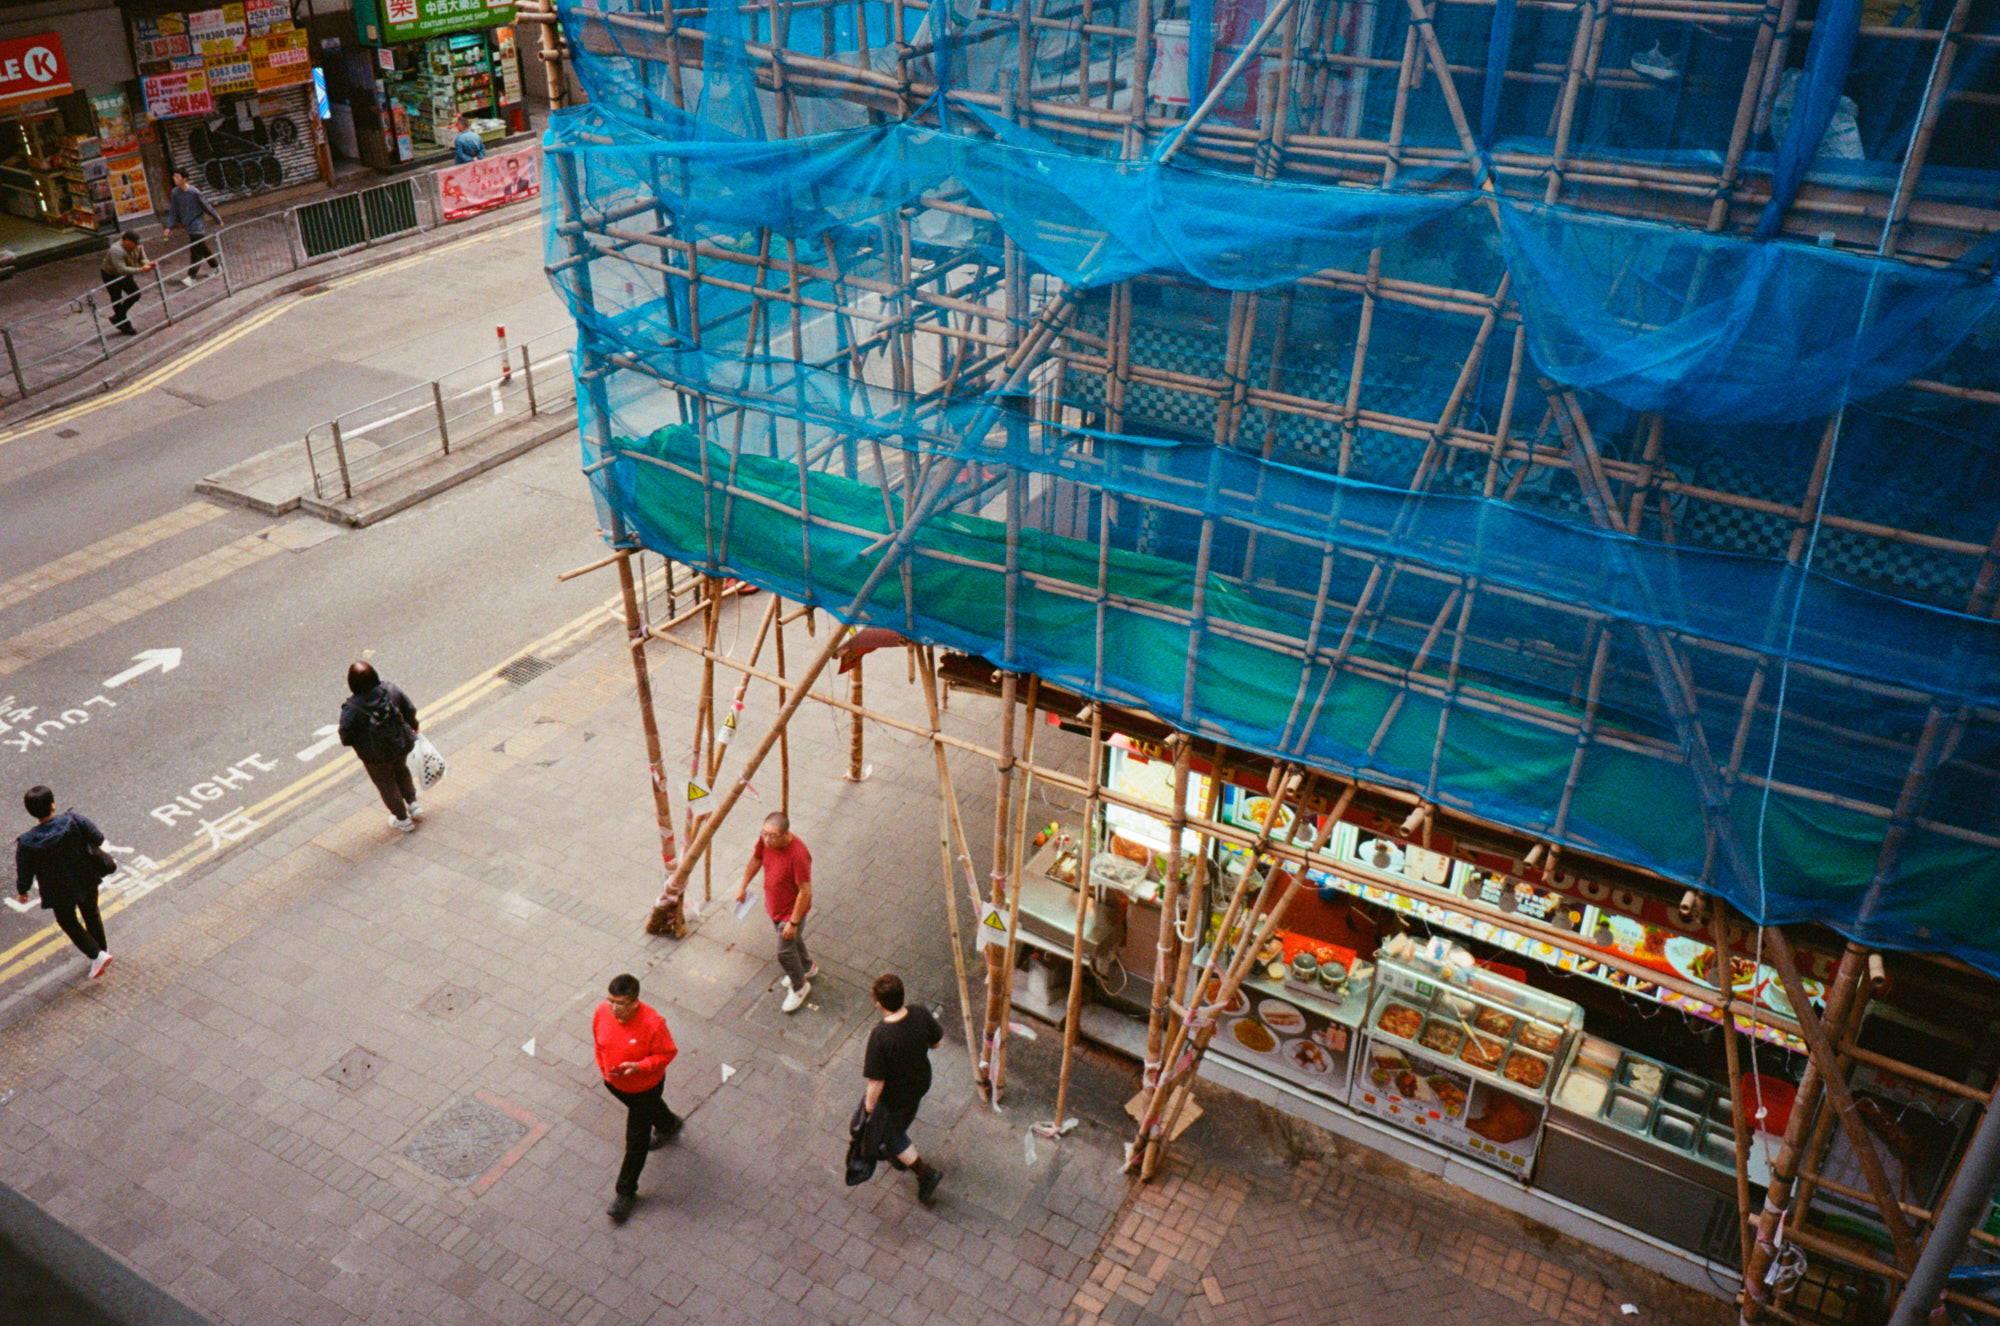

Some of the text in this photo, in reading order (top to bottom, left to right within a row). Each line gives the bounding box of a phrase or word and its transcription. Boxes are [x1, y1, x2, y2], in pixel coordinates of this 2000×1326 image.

[30, 50, 57, 78] K
[150, 752, 276, 827] RIGHT
[194, 805, 262, 851] 右
